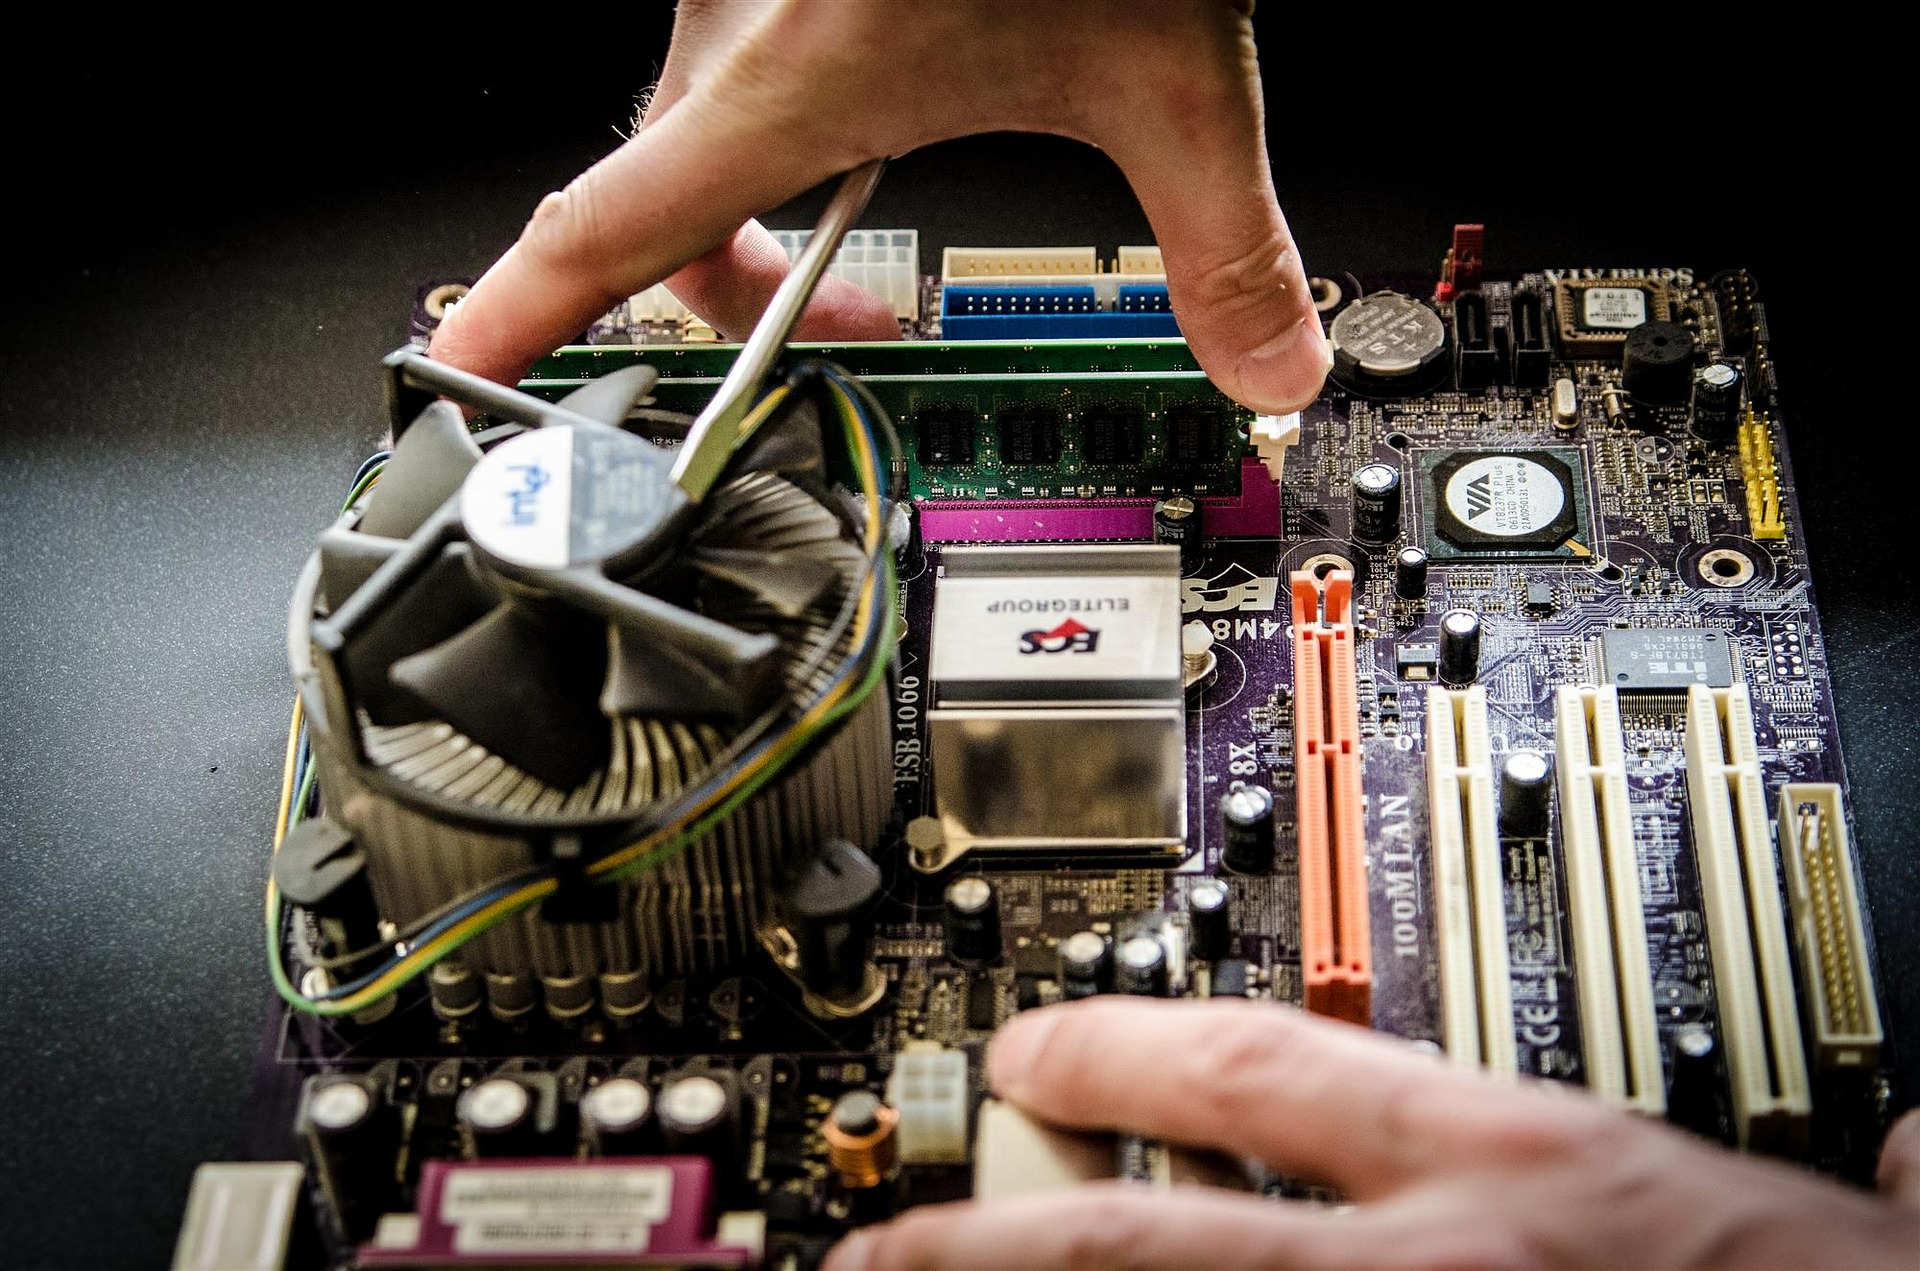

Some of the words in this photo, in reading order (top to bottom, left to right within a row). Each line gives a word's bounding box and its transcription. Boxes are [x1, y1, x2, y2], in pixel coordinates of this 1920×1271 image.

[1610, 268, 1694, 286] Serial
[1494, 465, 1503, 486] Plus
[1506, 475, 1515, 495] CHINA
[1467, 473, 1491, 520] VIA
[1494, 491, 1506, 527] VT8237R
[987, 598, 1129, 613] ELITEGROUP
[1019, 630, 1099, 655] ECS
[896, 676, 920, 731] 1066
[894, 738, 921, 782] FSB
[1229, 741, 1257, 775] 8X
